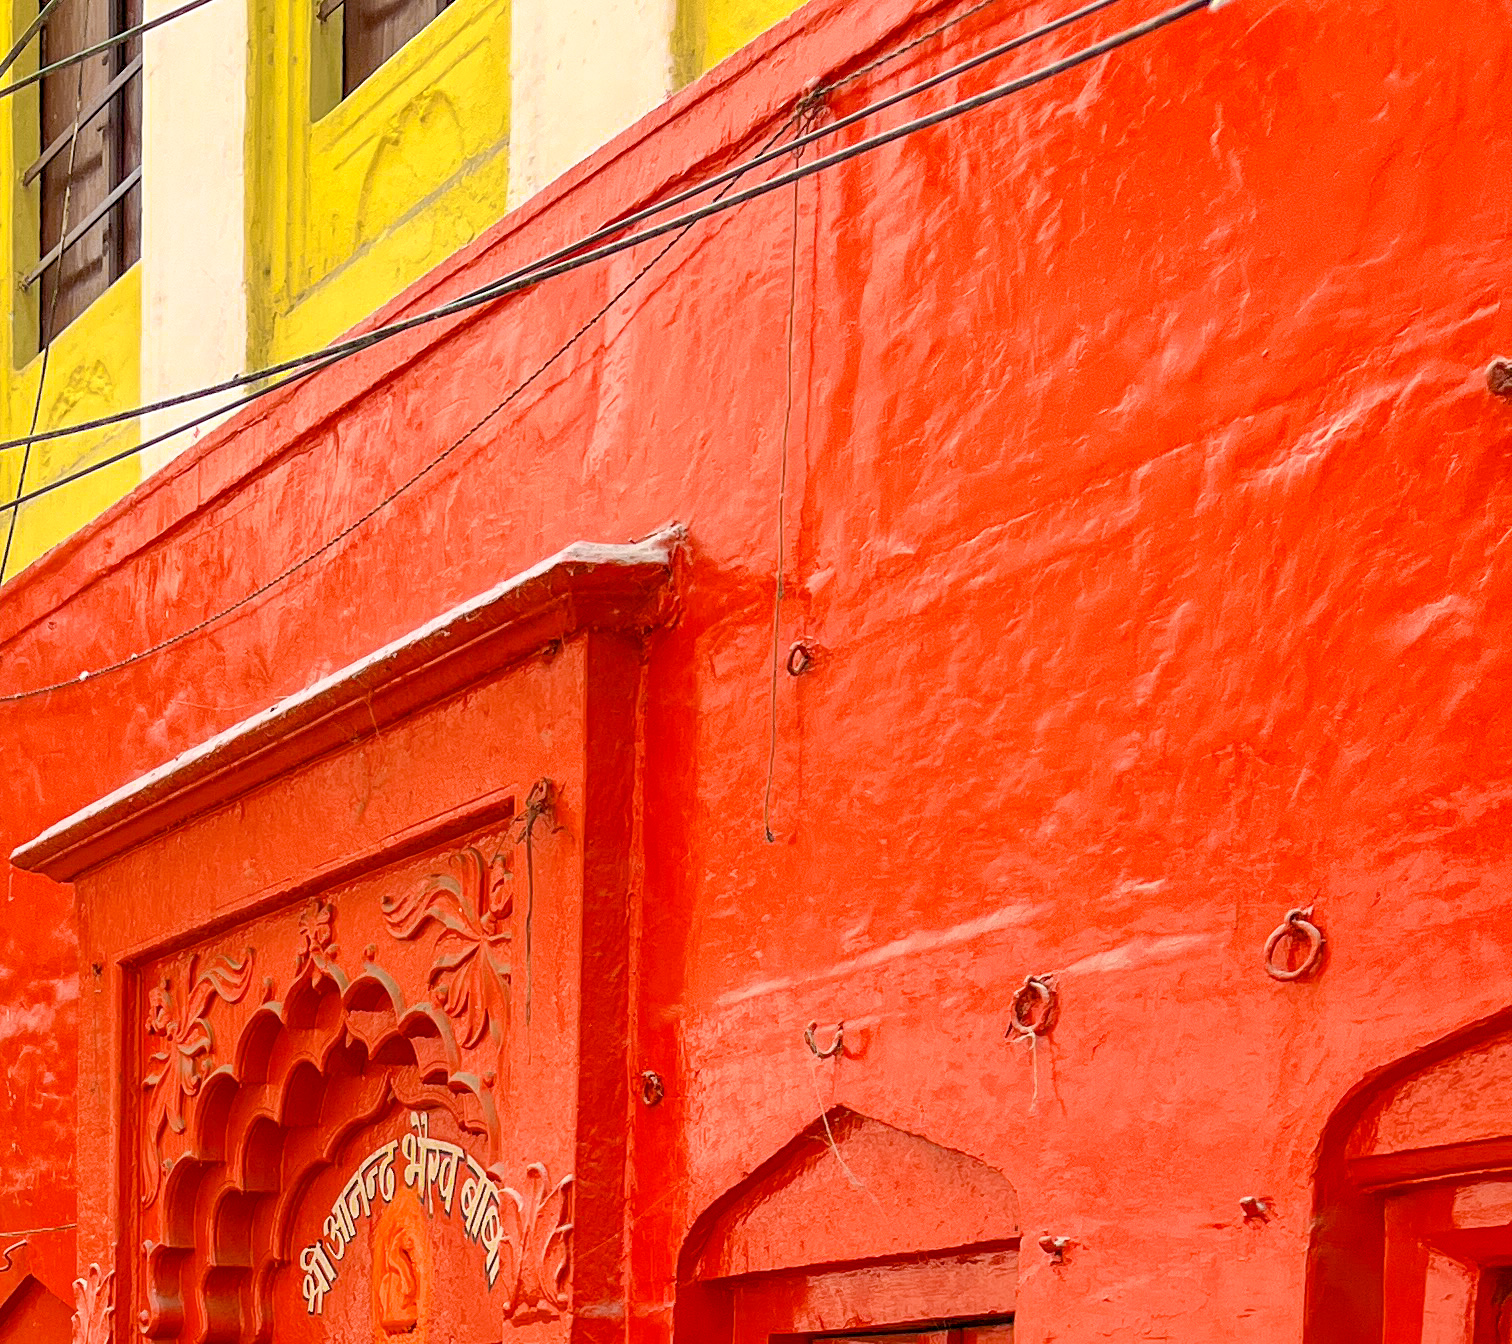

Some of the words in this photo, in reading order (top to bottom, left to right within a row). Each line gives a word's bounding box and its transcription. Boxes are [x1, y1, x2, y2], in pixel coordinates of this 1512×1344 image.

[300, 1240, 338, 1314] श्री
[323, 1139, 399, 1260] आनन्द
[402, 1111, 465, 1216] भैरव
[461, 1154, 501, 1290] बाबा
